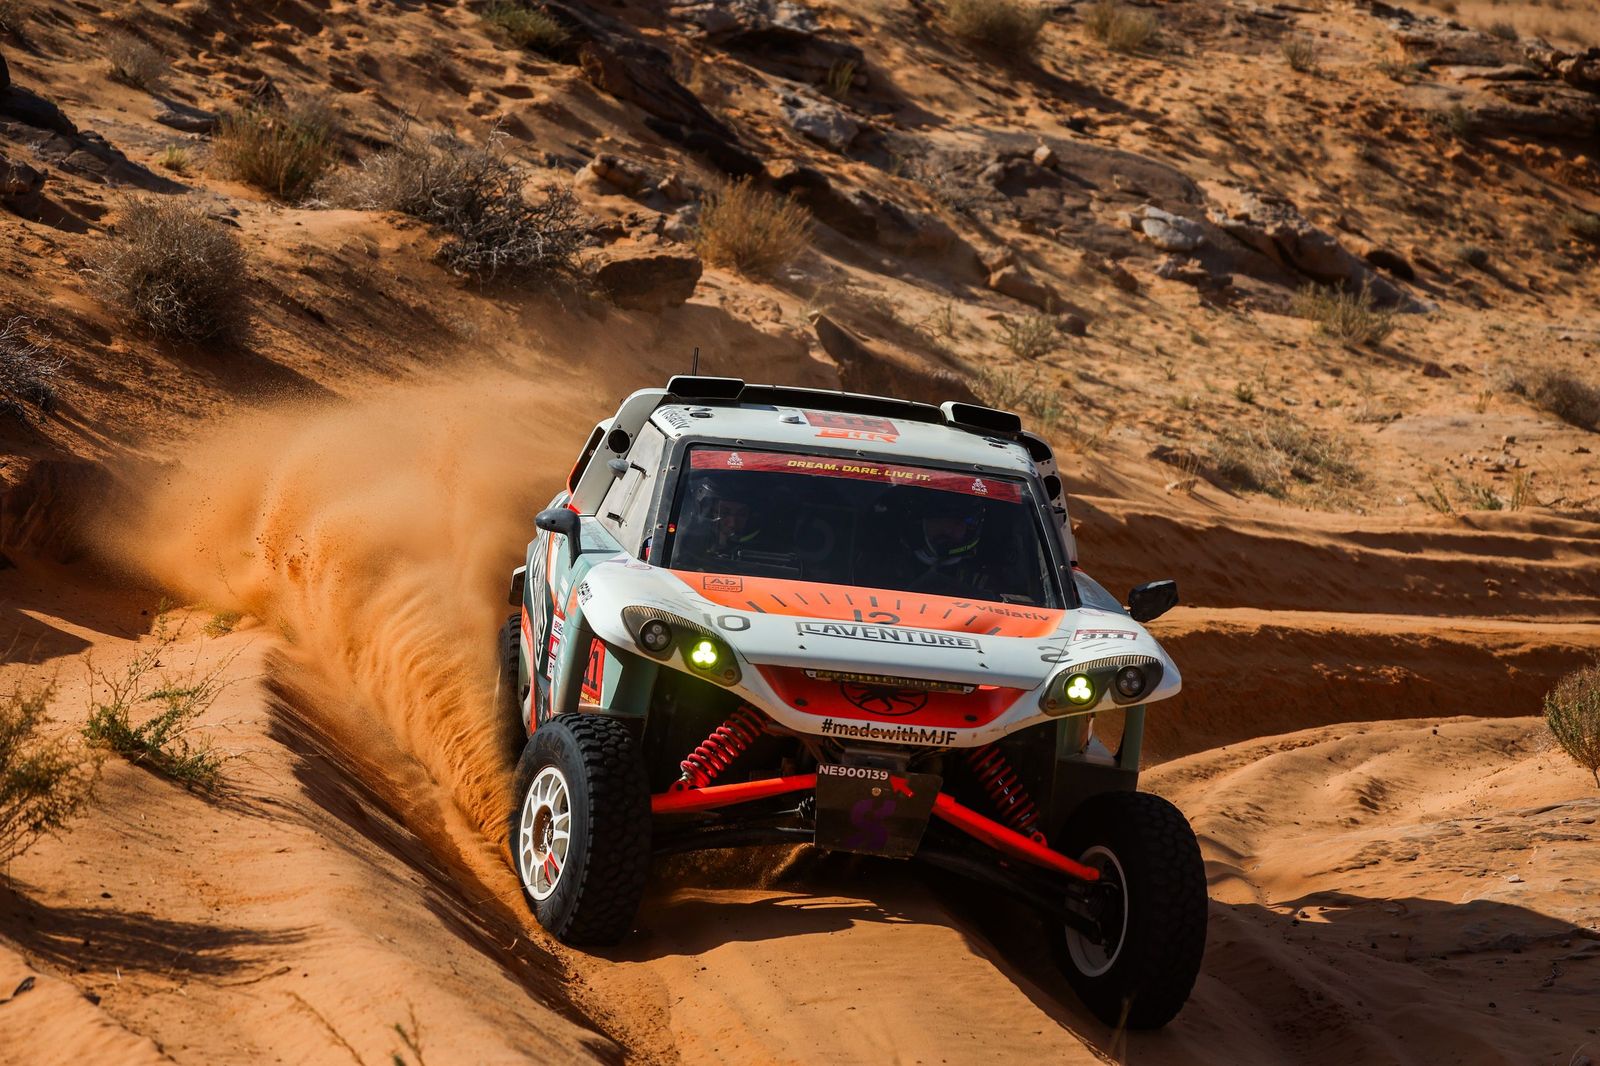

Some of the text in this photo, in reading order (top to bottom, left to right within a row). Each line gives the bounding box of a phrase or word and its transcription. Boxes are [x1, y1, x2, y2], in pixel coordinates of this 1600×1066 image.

[786, 460, 931, 481] DREAM. DARE. LIVE IT.
[710, 578, 736, 586] Ab
[703, 613, 751, 631] 10
[975, 605, 1049, 621] visiativ
[803, 623, 972, 647] LAVENTURE
[821, 718, 957, 745] #madewithMJF
[818, 765, 889, 781] NE900139
